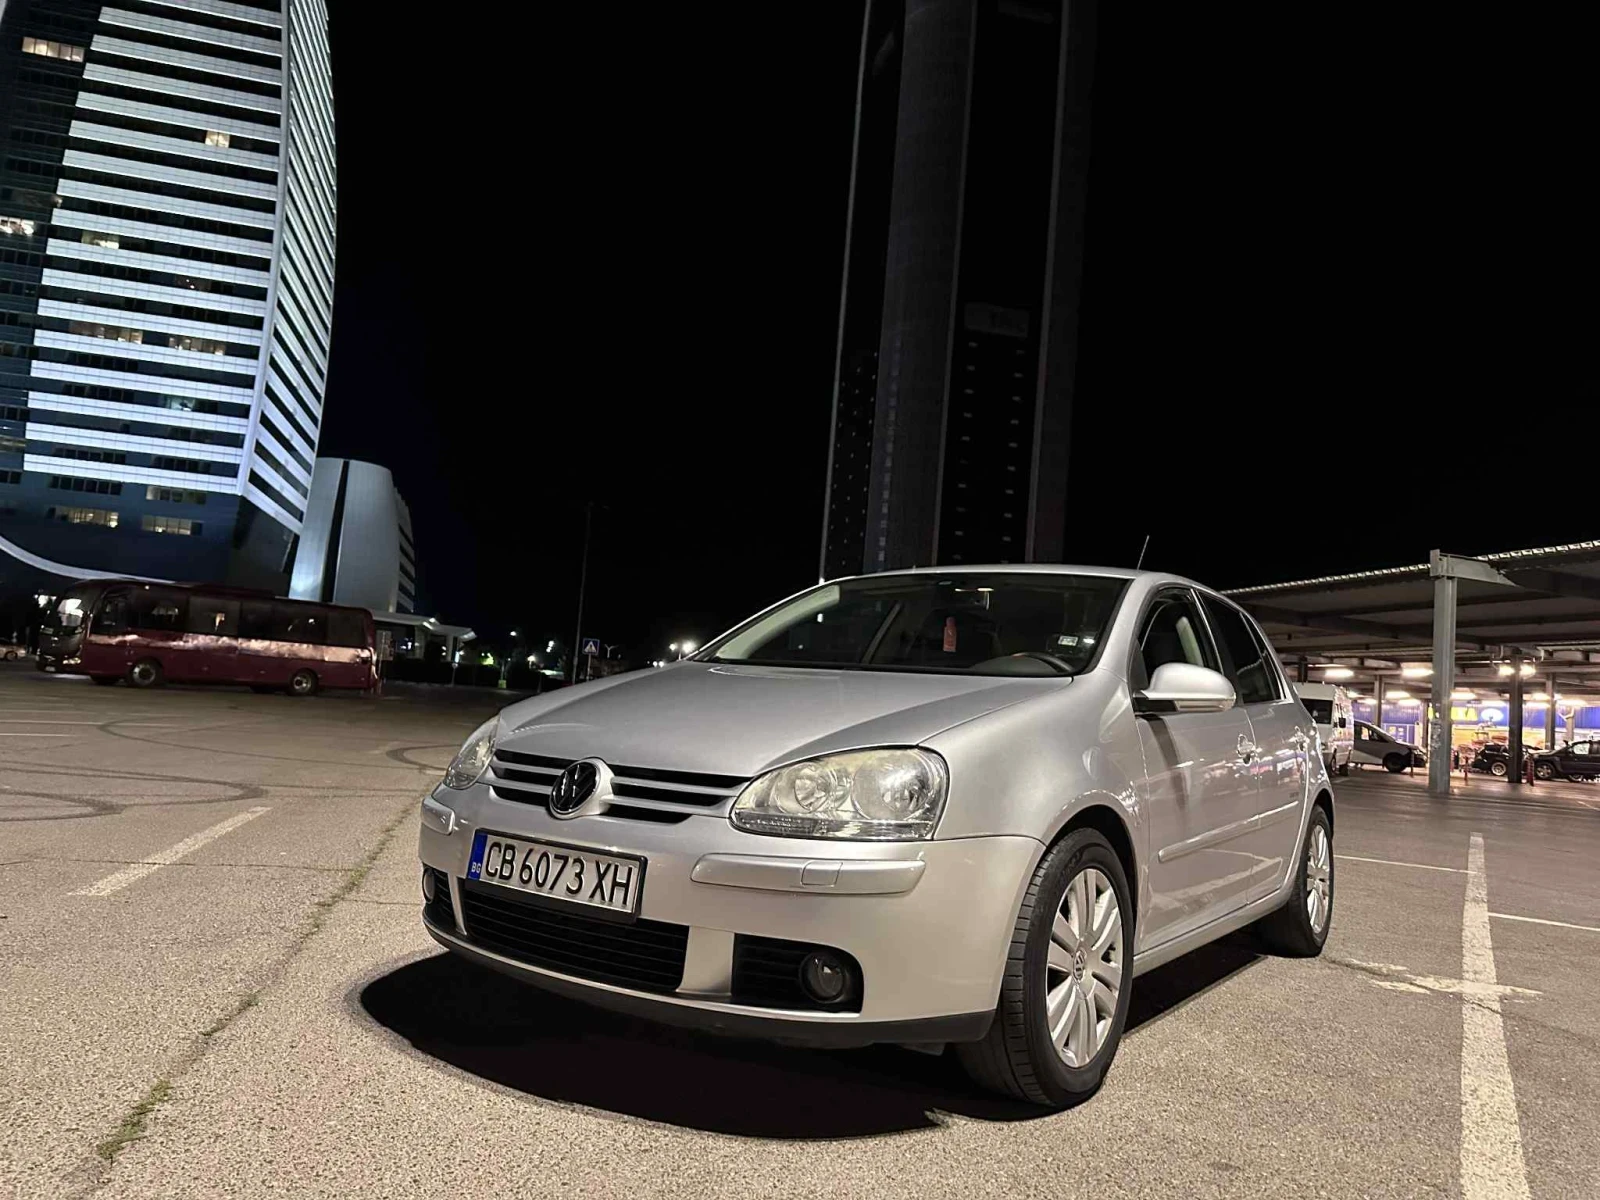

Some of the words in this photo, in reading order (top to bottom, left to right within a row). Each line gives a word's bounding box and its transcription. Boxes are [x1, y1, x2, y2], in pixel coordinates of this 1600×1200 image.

[471, 862, 482, 874] BG
[485, 841, 516, 880] CB
[519, 848, 585, 894] 6073
[589, 859, 633, 905] XH
